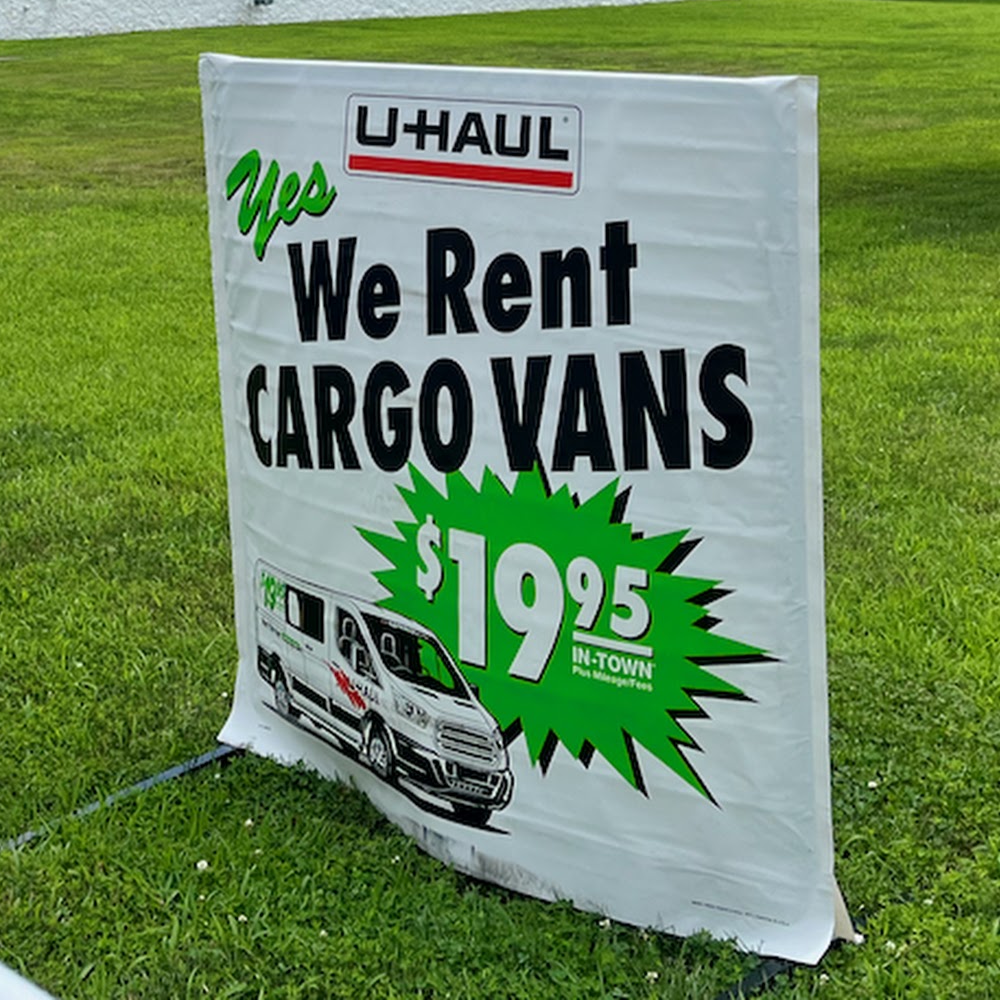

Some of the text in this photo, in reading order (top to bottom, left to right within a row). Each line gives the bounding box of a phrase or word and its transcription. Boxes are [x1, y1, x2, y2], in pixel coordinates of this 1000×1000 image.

[356, 106, 569, 161] U-HAUL
[226, 149, 337, 261] Yes
[288, 220, 637, 341] We Rent
[247, 343, 755, 473] CARGO VANS
[572, 646, 653, 680] IN-TOWN
